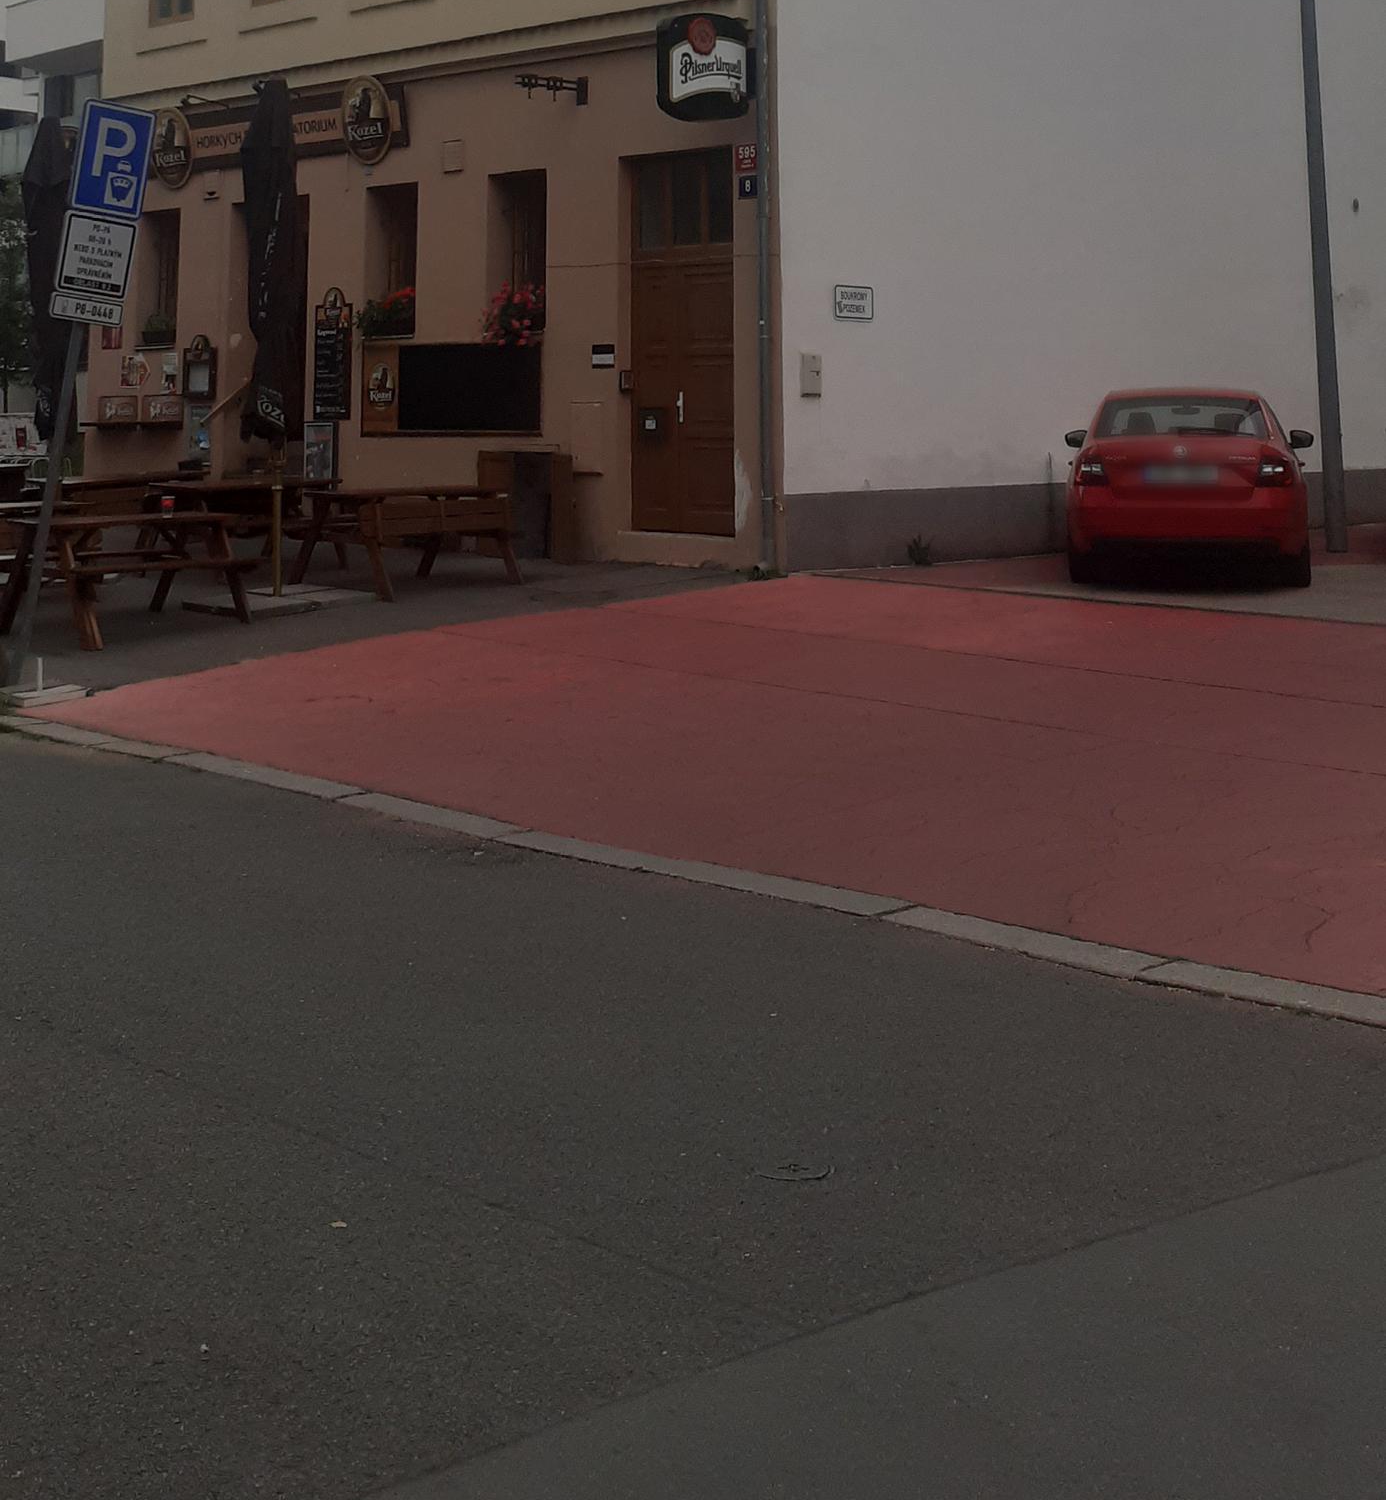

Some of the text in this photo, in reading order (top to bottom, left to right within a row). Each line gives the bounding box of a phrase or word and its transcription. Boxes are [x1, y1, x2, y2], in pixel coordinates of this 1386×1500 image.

[680, 52, 742, 84] Pilsner Urquell
[346, 121, 384, 141] Kozel
[91, 116, 136, 177] P
[738, 145, 756, 159] 595
[153, 148, 188, 167] Kozel
[745, 179, 751, 192] 8
